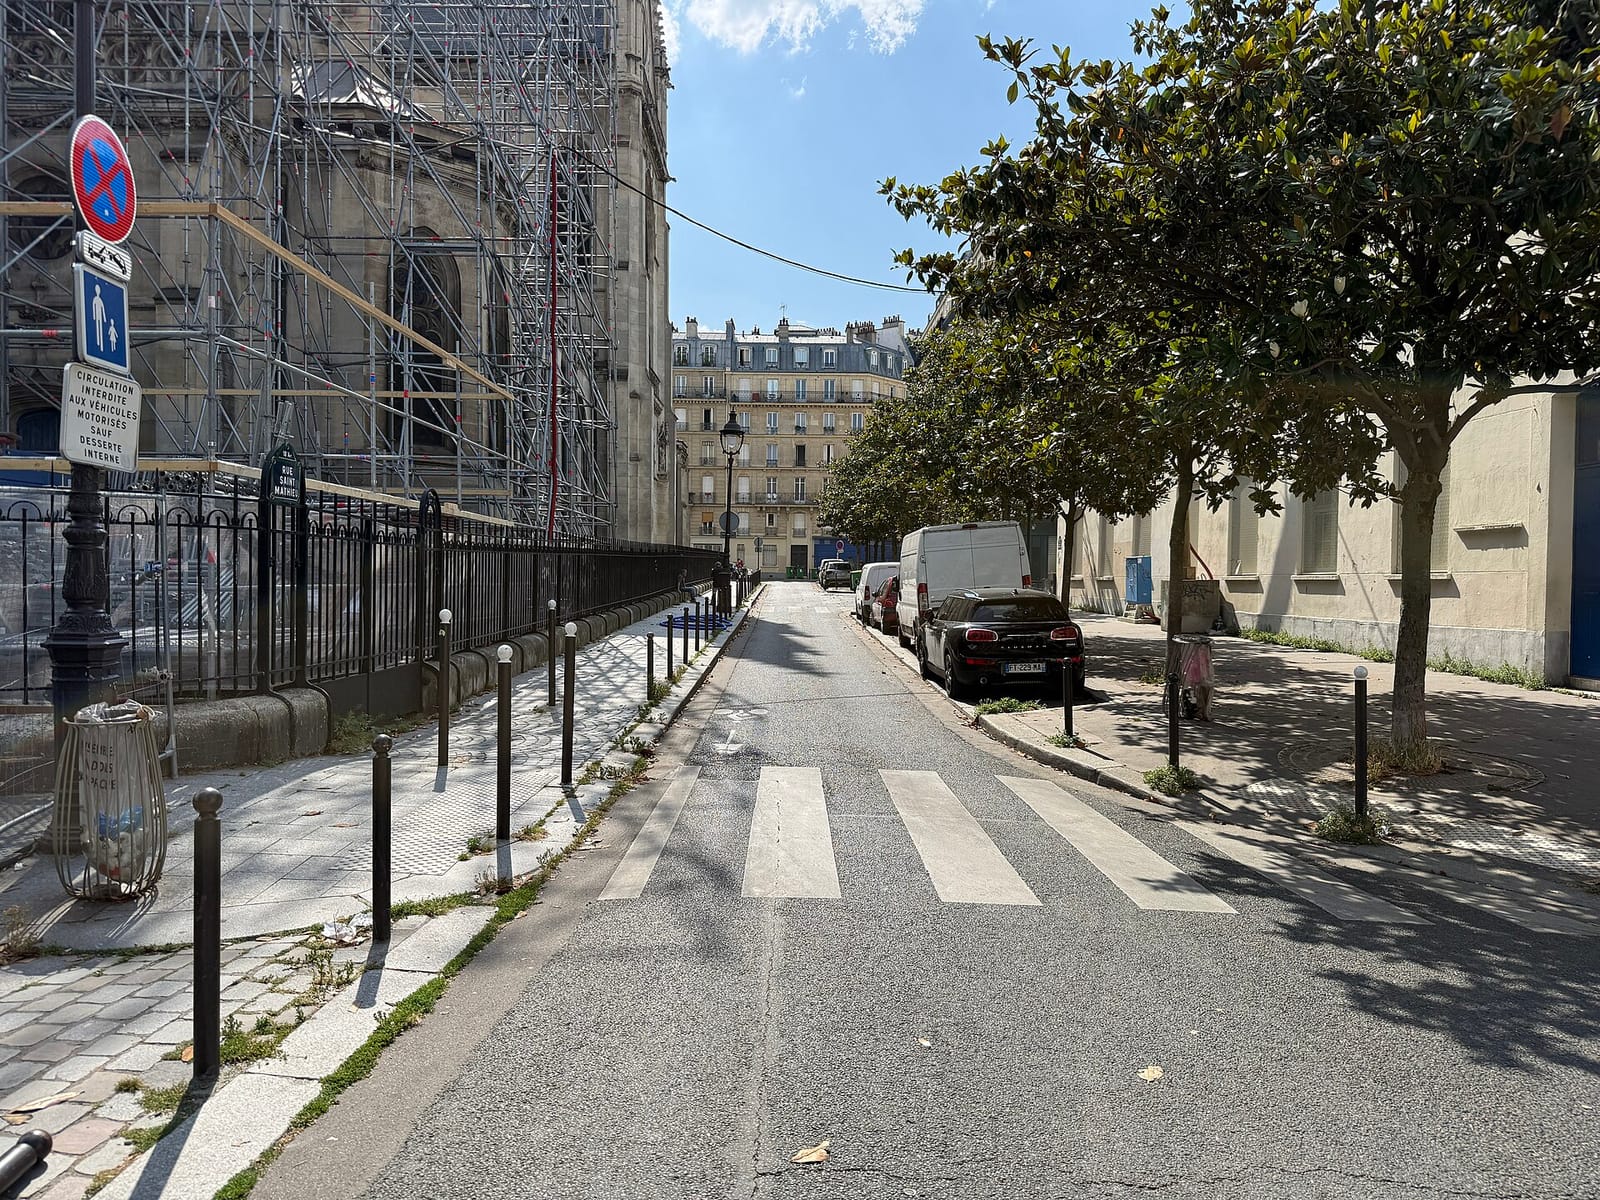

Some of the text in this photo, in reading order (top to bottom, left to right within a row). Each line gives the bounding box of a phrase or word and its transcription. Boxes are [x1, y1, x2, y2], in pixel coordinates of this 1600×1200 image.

[77, 371, 134, 395] CIRCULATION
[82, 385, 127, 406] INTERDITE
[69, 394, 138, 421] AUX VÉHICULES
[77, 409, 127, 430] MOTORISÉS
[90, 425, 113, 439] SAUF
[80, 435, 122, 453] DESSERTE
[84, 448, 120, 464] INTERNE
[282, 465, 293, 476] RUE
[279, 475, 296, 487] SAINT
